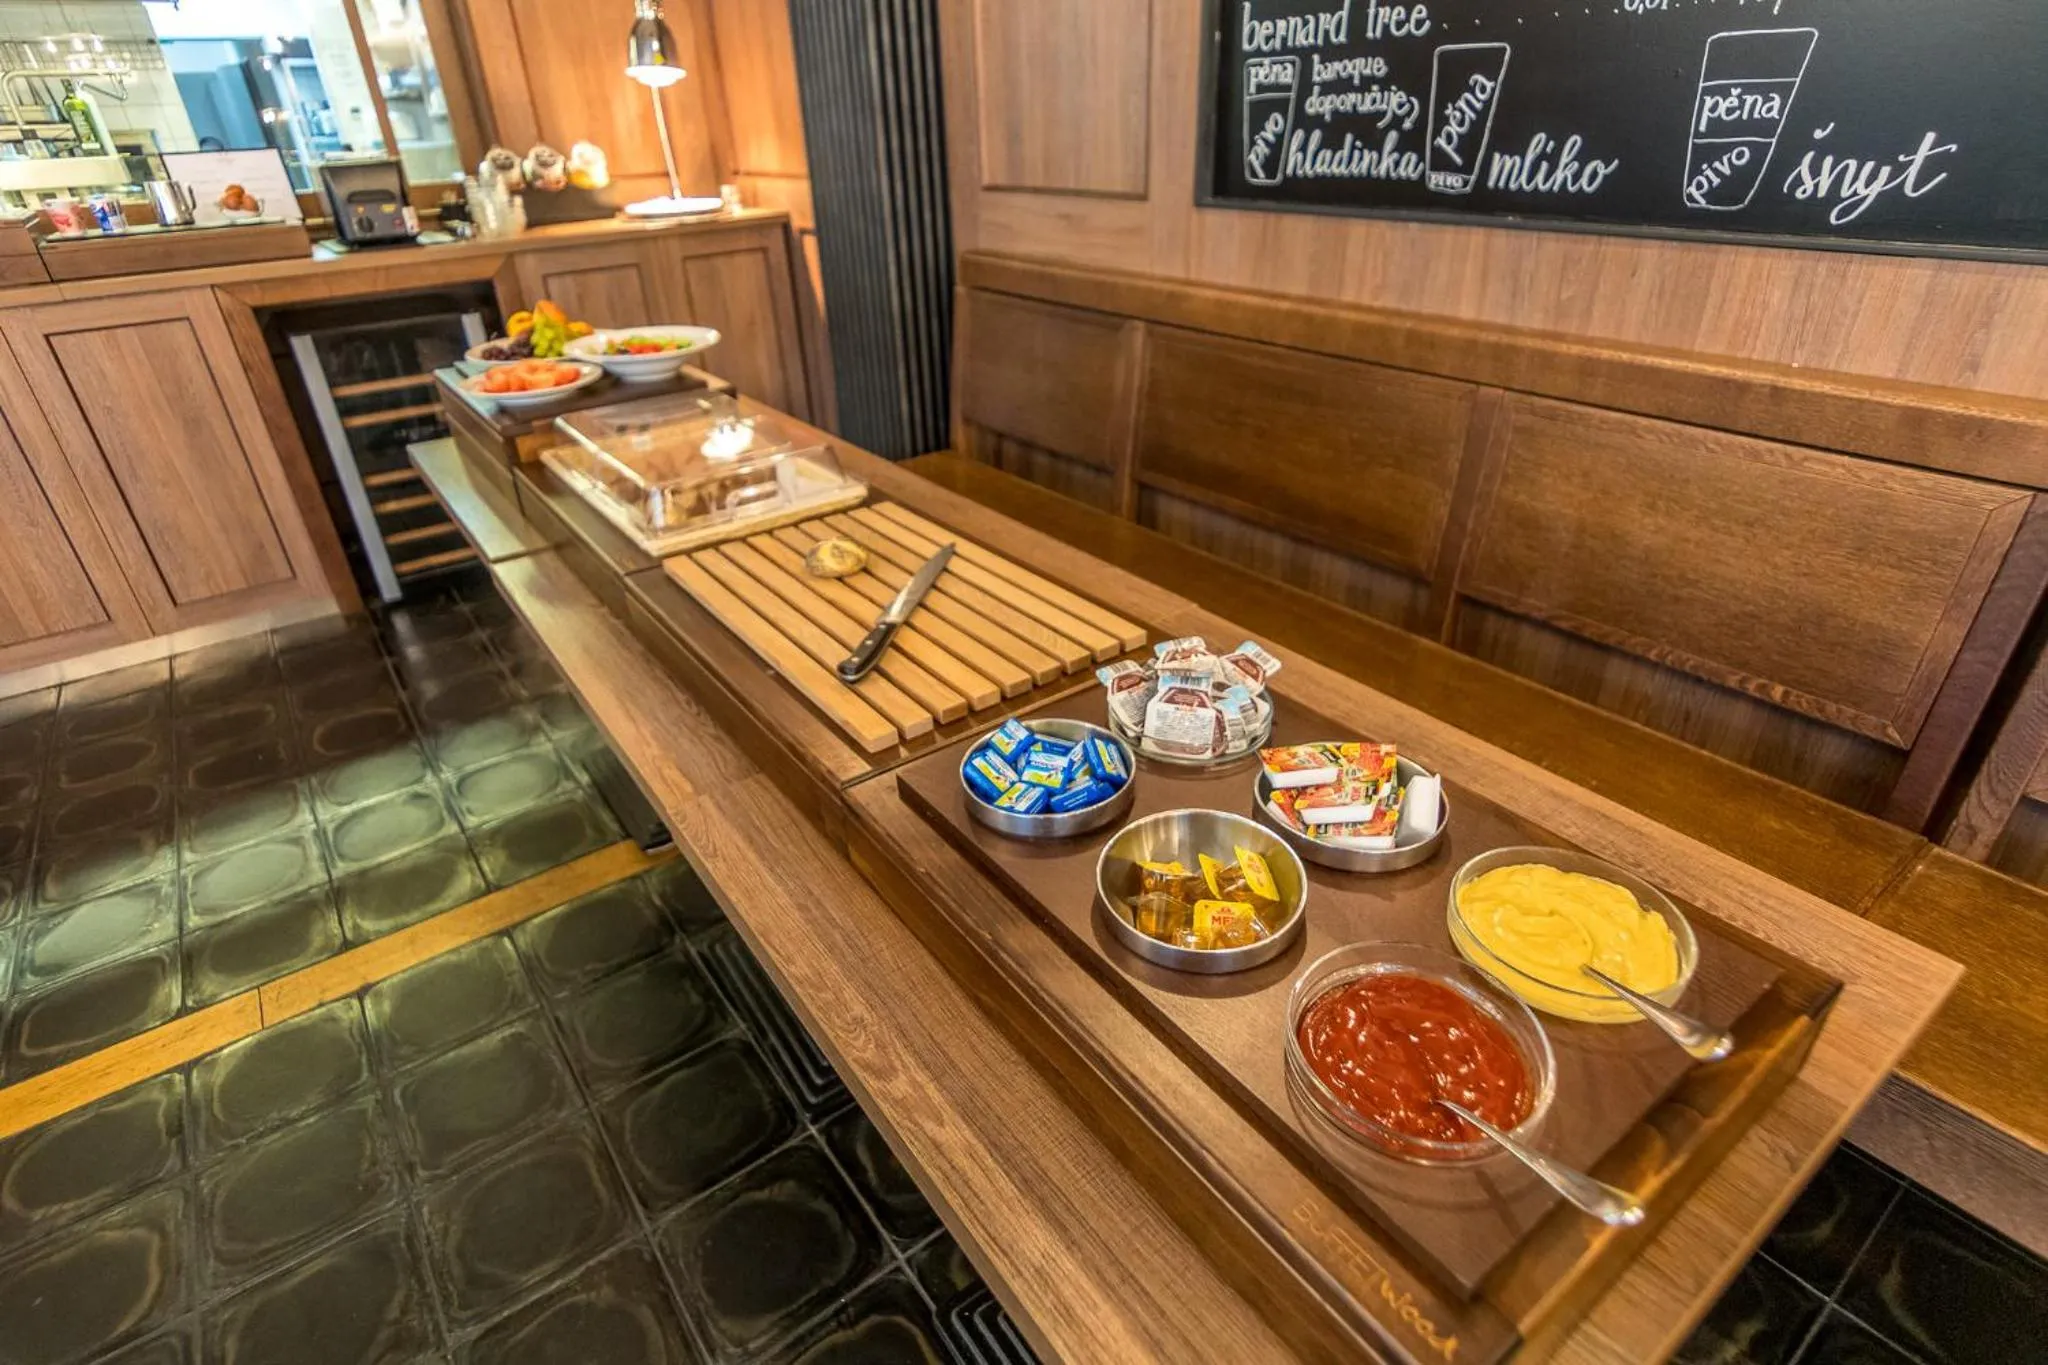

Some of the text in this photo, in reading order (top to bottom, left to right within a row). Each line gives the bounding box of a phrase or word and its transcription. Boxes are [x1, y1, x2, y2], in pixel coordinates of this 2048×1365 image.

[1242, 0, 1349, 51] bernard
[1249, 59, 1294, 94] pěna
[1312, 53, 1388, 86] baroque
[1434, 73, 1496, 166] pěna
[1698, 88, 1780, 132] pěna
[1248, 112, 1284, 178] pivo
[1286, 129, 1424, 180] hladinka
[1430, 173, 1464, 187] pivo
[1686, 146, 1750, 204] pivo
[1784, 122, 1957, 225] šnyt
